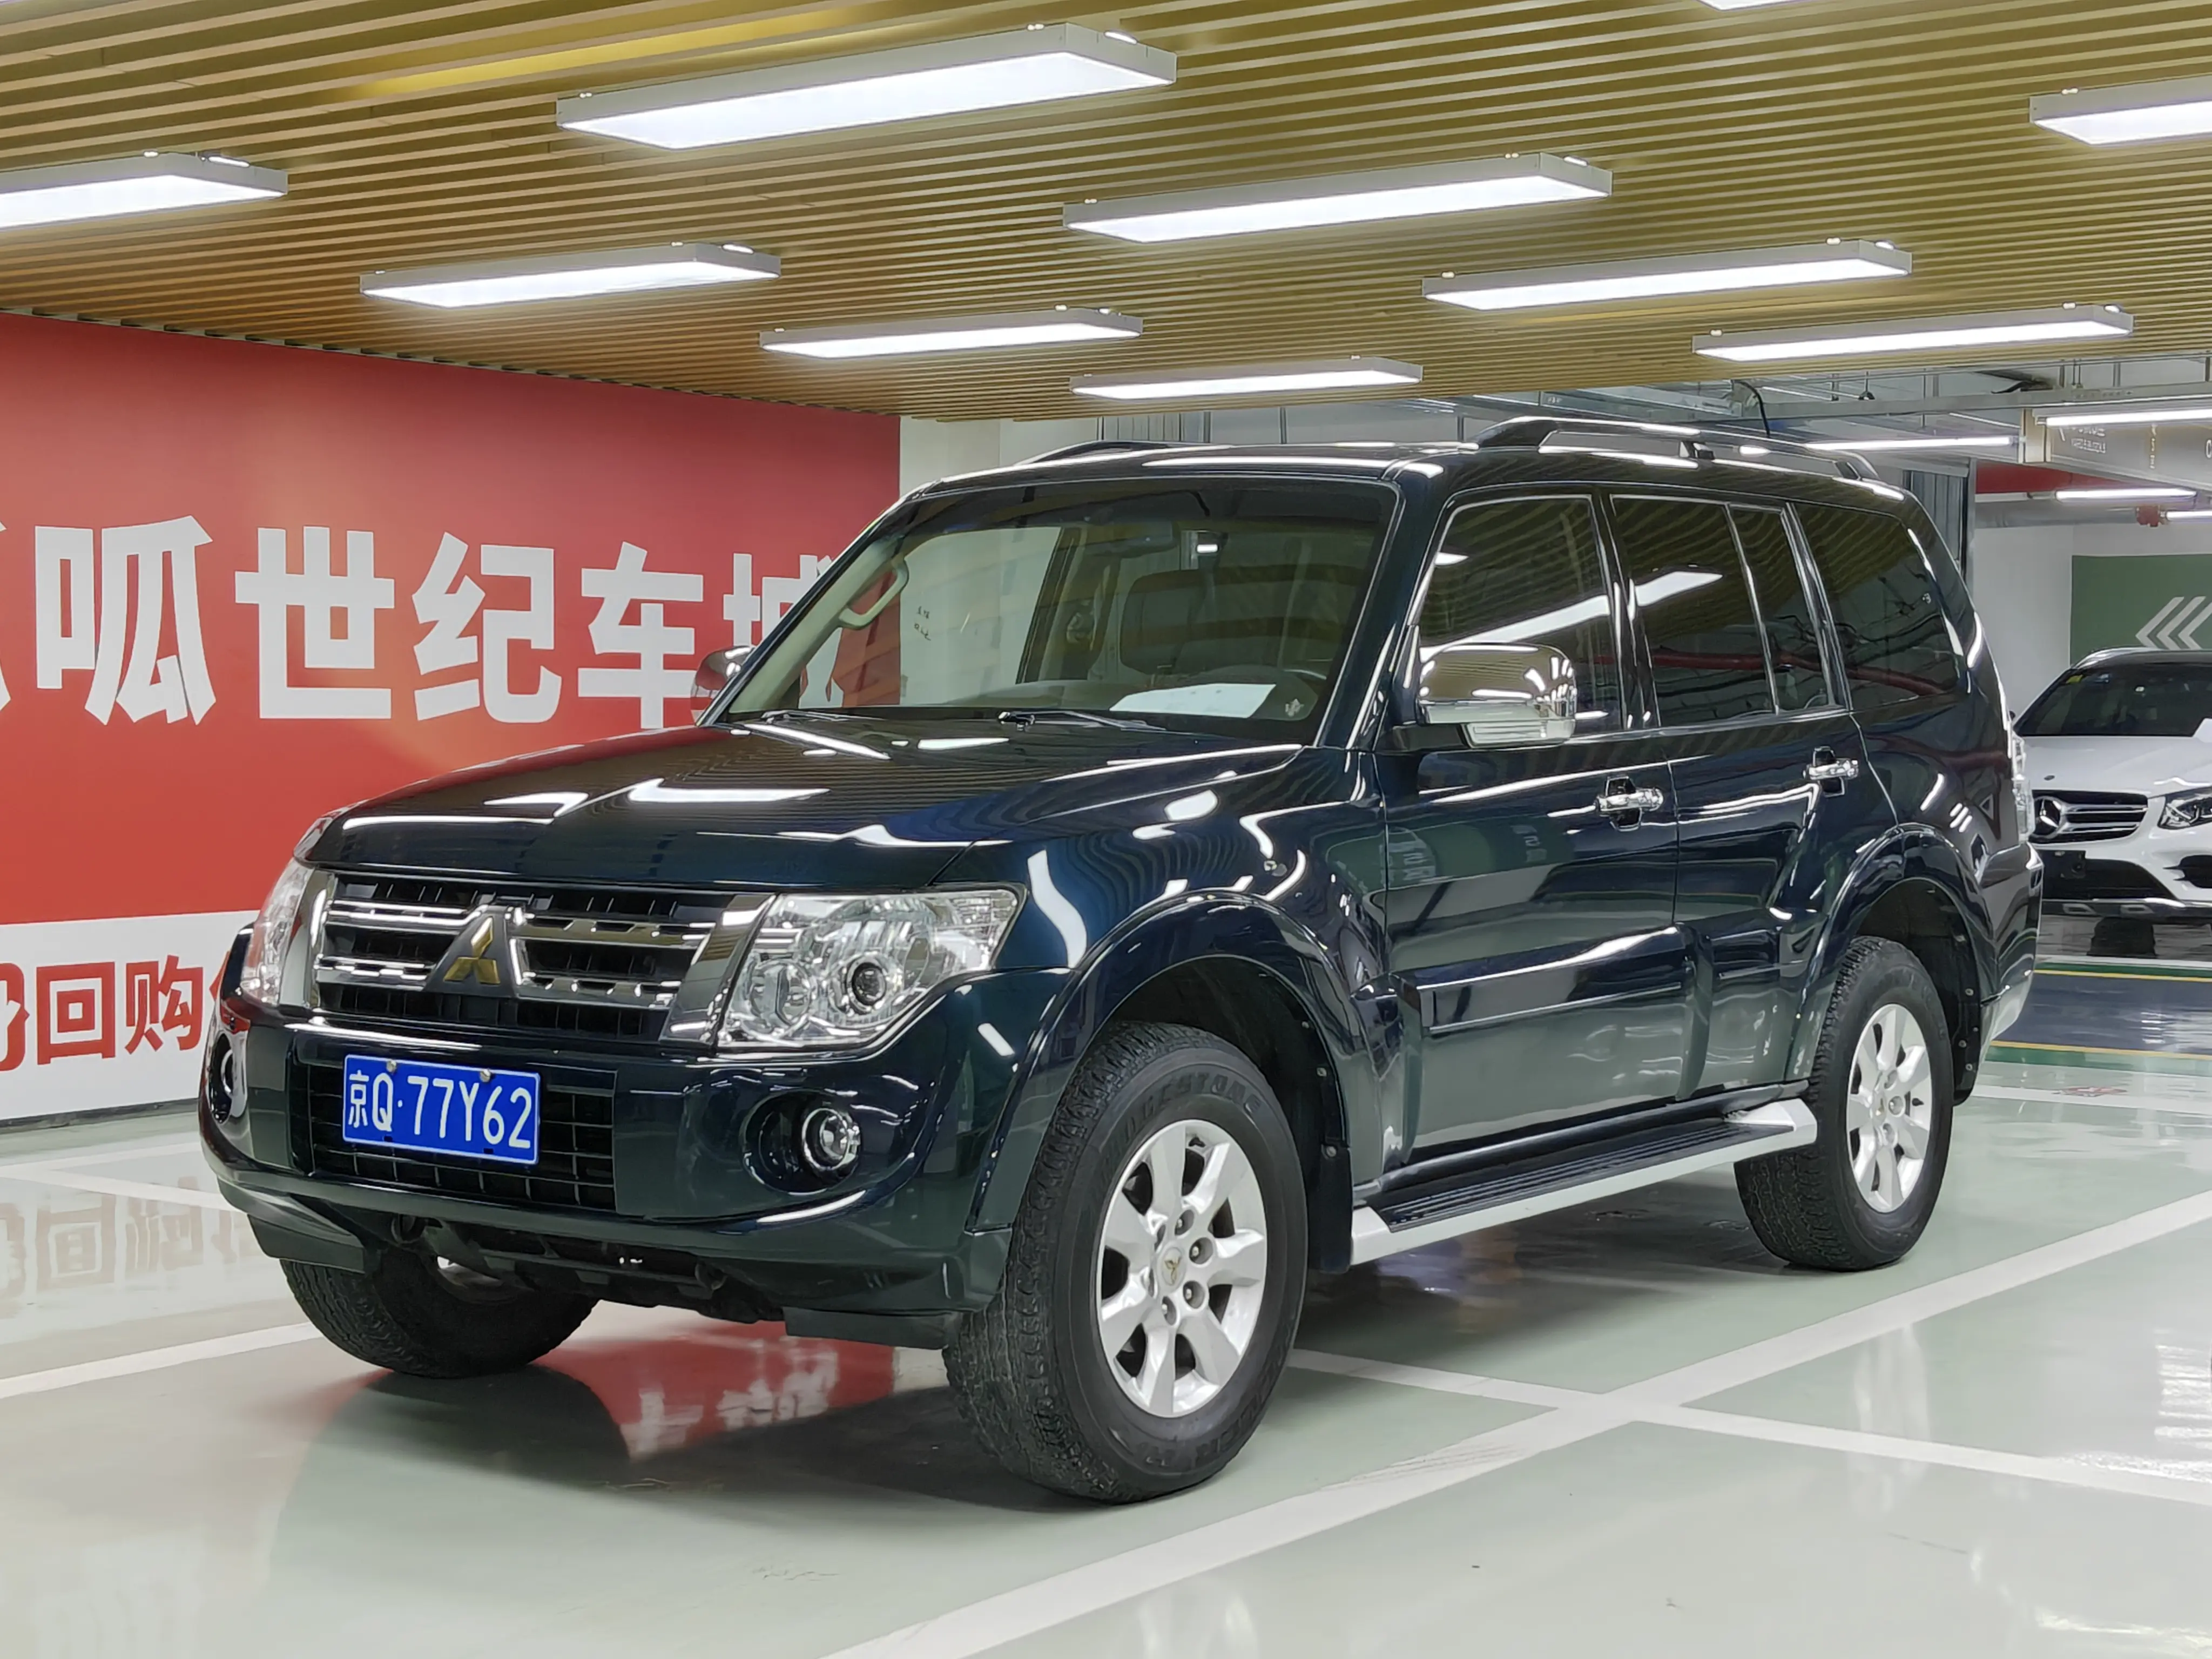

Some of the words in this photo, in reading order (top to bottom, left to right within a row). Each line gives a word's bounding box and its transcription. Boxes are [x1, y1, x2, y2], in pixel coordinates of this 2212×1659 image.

[0, 515, 845, 728] 呱世纪车
[0, 951, 229, 1071] 回购
[348, 1070, 532, 1149] 京Q·77Y62
